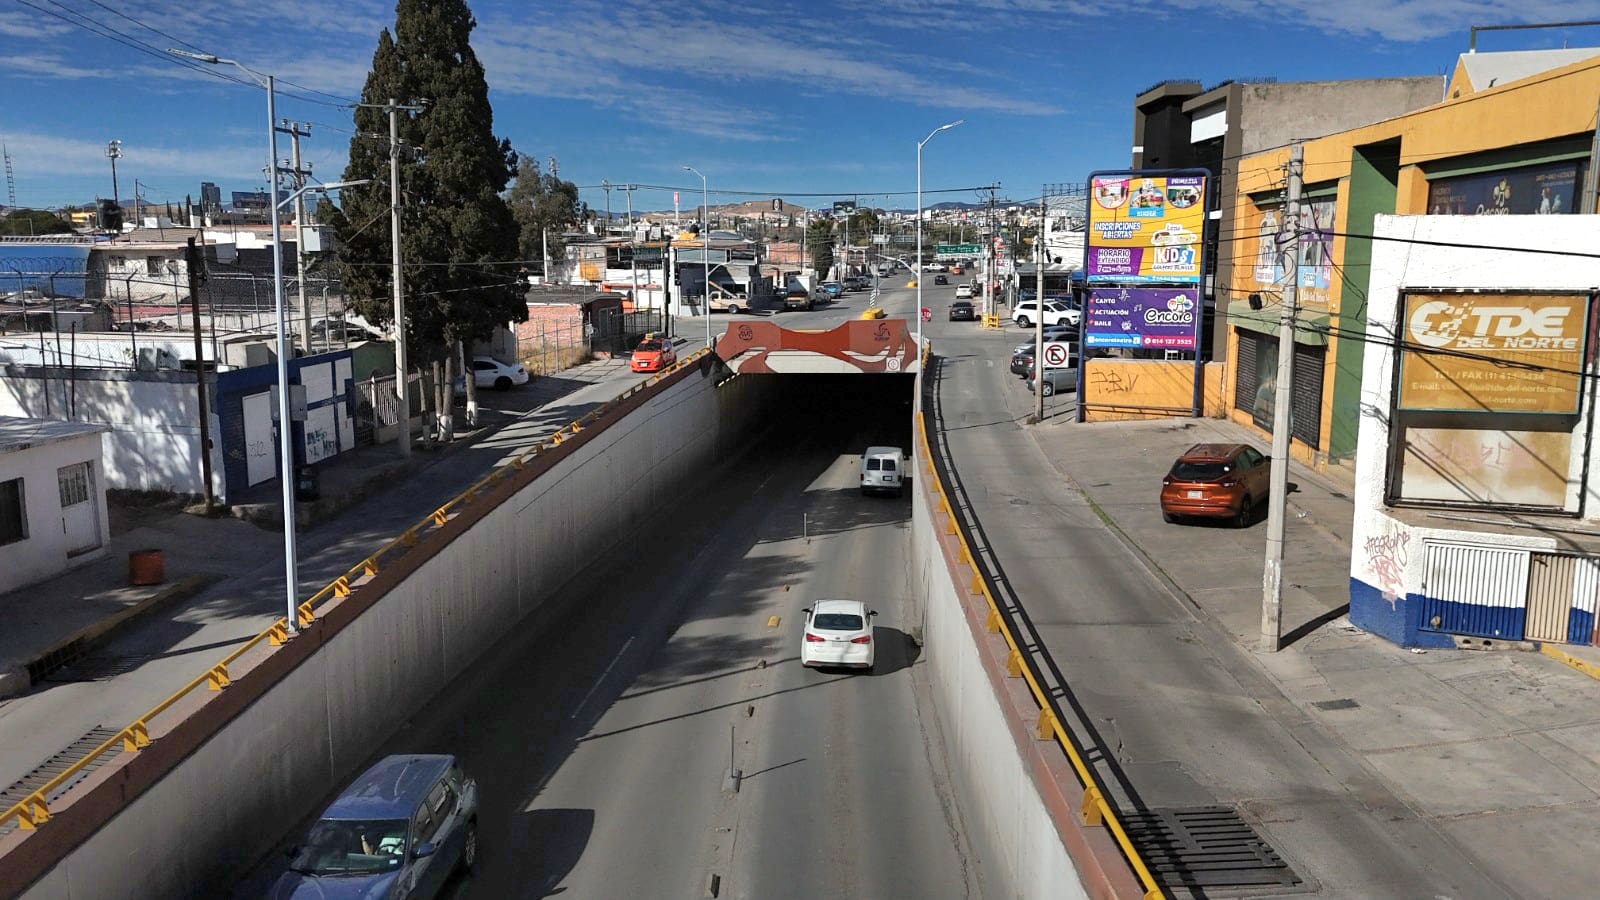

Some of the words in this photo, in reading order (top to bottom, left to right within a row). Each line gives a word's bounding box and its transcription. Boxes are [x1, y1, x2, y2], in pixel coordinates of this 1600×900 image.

[1094, 221, 1141, 231] INSCRIPCIONES
[1102, 230, 1132, 239] ABIERTAS
[1098, 249, 1131, 257] HORARIO
[1471, 307, 1571, 337] TDE
[1456, 337, 1496, 348] DEL
[1503, 337, 1579, 349] NORTE
[1462, 371, 1482, 379] FAX
